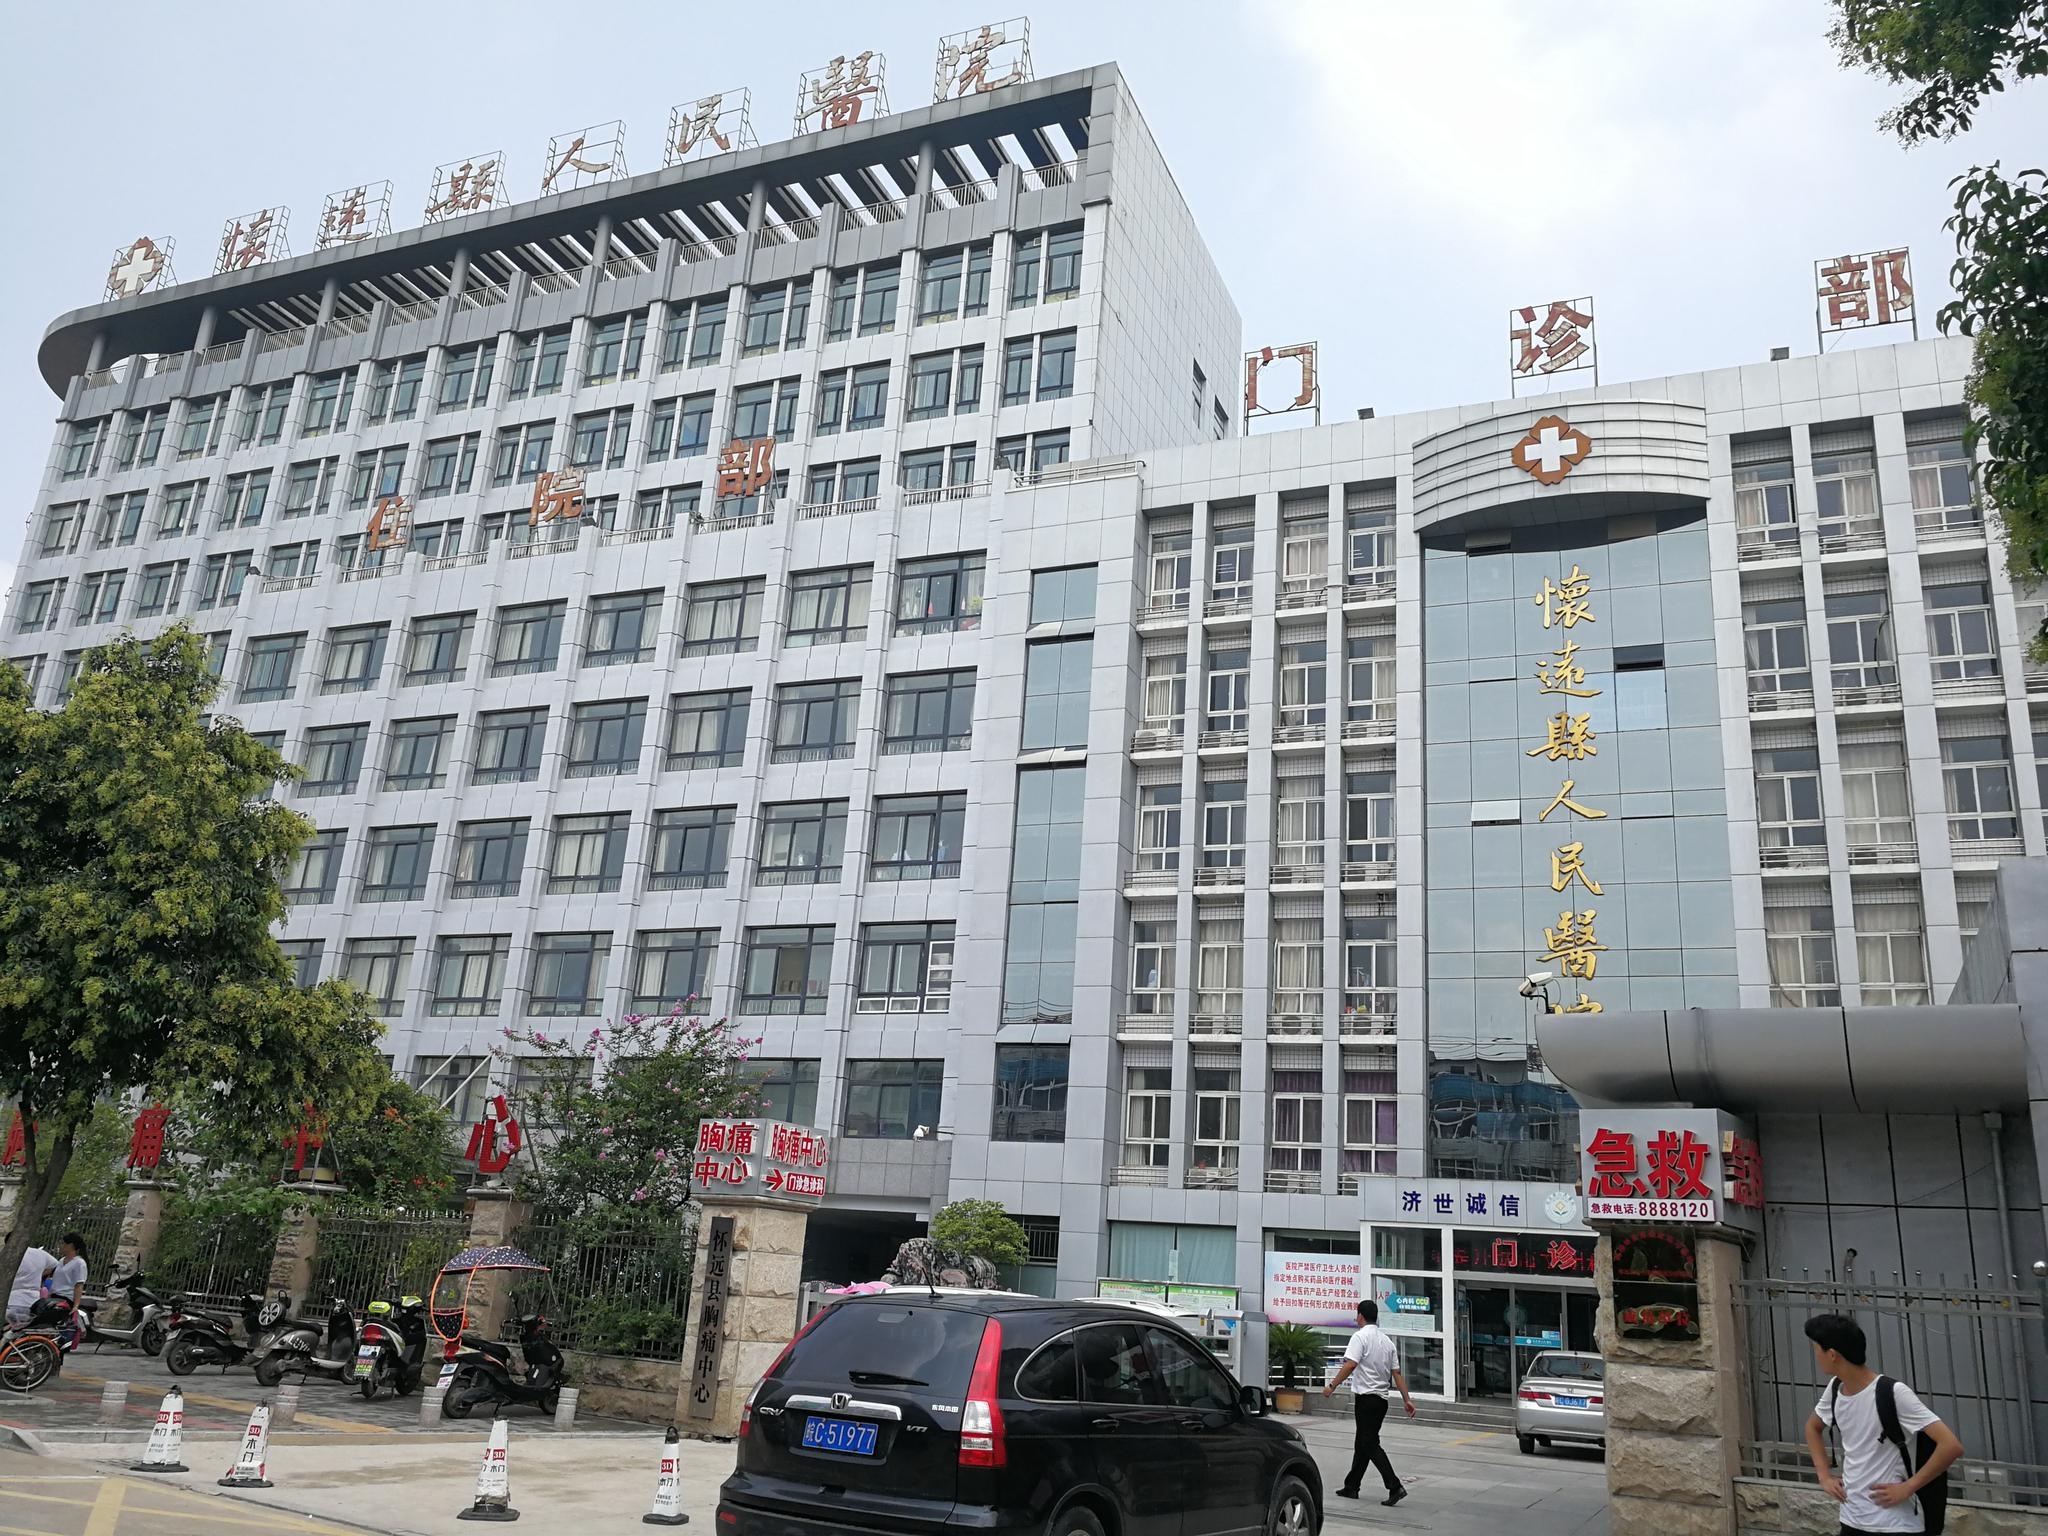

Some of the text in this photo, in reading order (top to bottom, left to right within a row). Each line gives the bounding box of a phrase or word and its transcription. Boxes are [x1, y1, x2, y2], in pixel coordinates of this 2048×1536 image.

[1247, 250, 1913, 410] 门诊部
[368, 437, 775, 551] 住院部
[698, 1122, 758, 1154] 胸痛
[770, 1123, 827, 1167] 胸痛中心
[694, 1156, 748, 1187] 中心
[1586, 1128, 1713, 1199] 急救
[788, 1174, 825, 1195] 门诊急诊科
[1402, 1191, 1520, 1217] 济世诚信
[1492, 1238, 1577, 1270] 门诊
[694, 1230, 728, 1404] 怀远县胸痛中心
[157, 1413, 169, 1422] 3D
[931, 1404, 960, 1414] 东风本田
[250, 1426, 261, 1435] 3D
[242, 1438, 257, 1463] 木门
[493, 1451, 505, 1459] 3D
[490, 1464, 506, 1473] 木门
[661, 1462, 673, 1470] 3D
